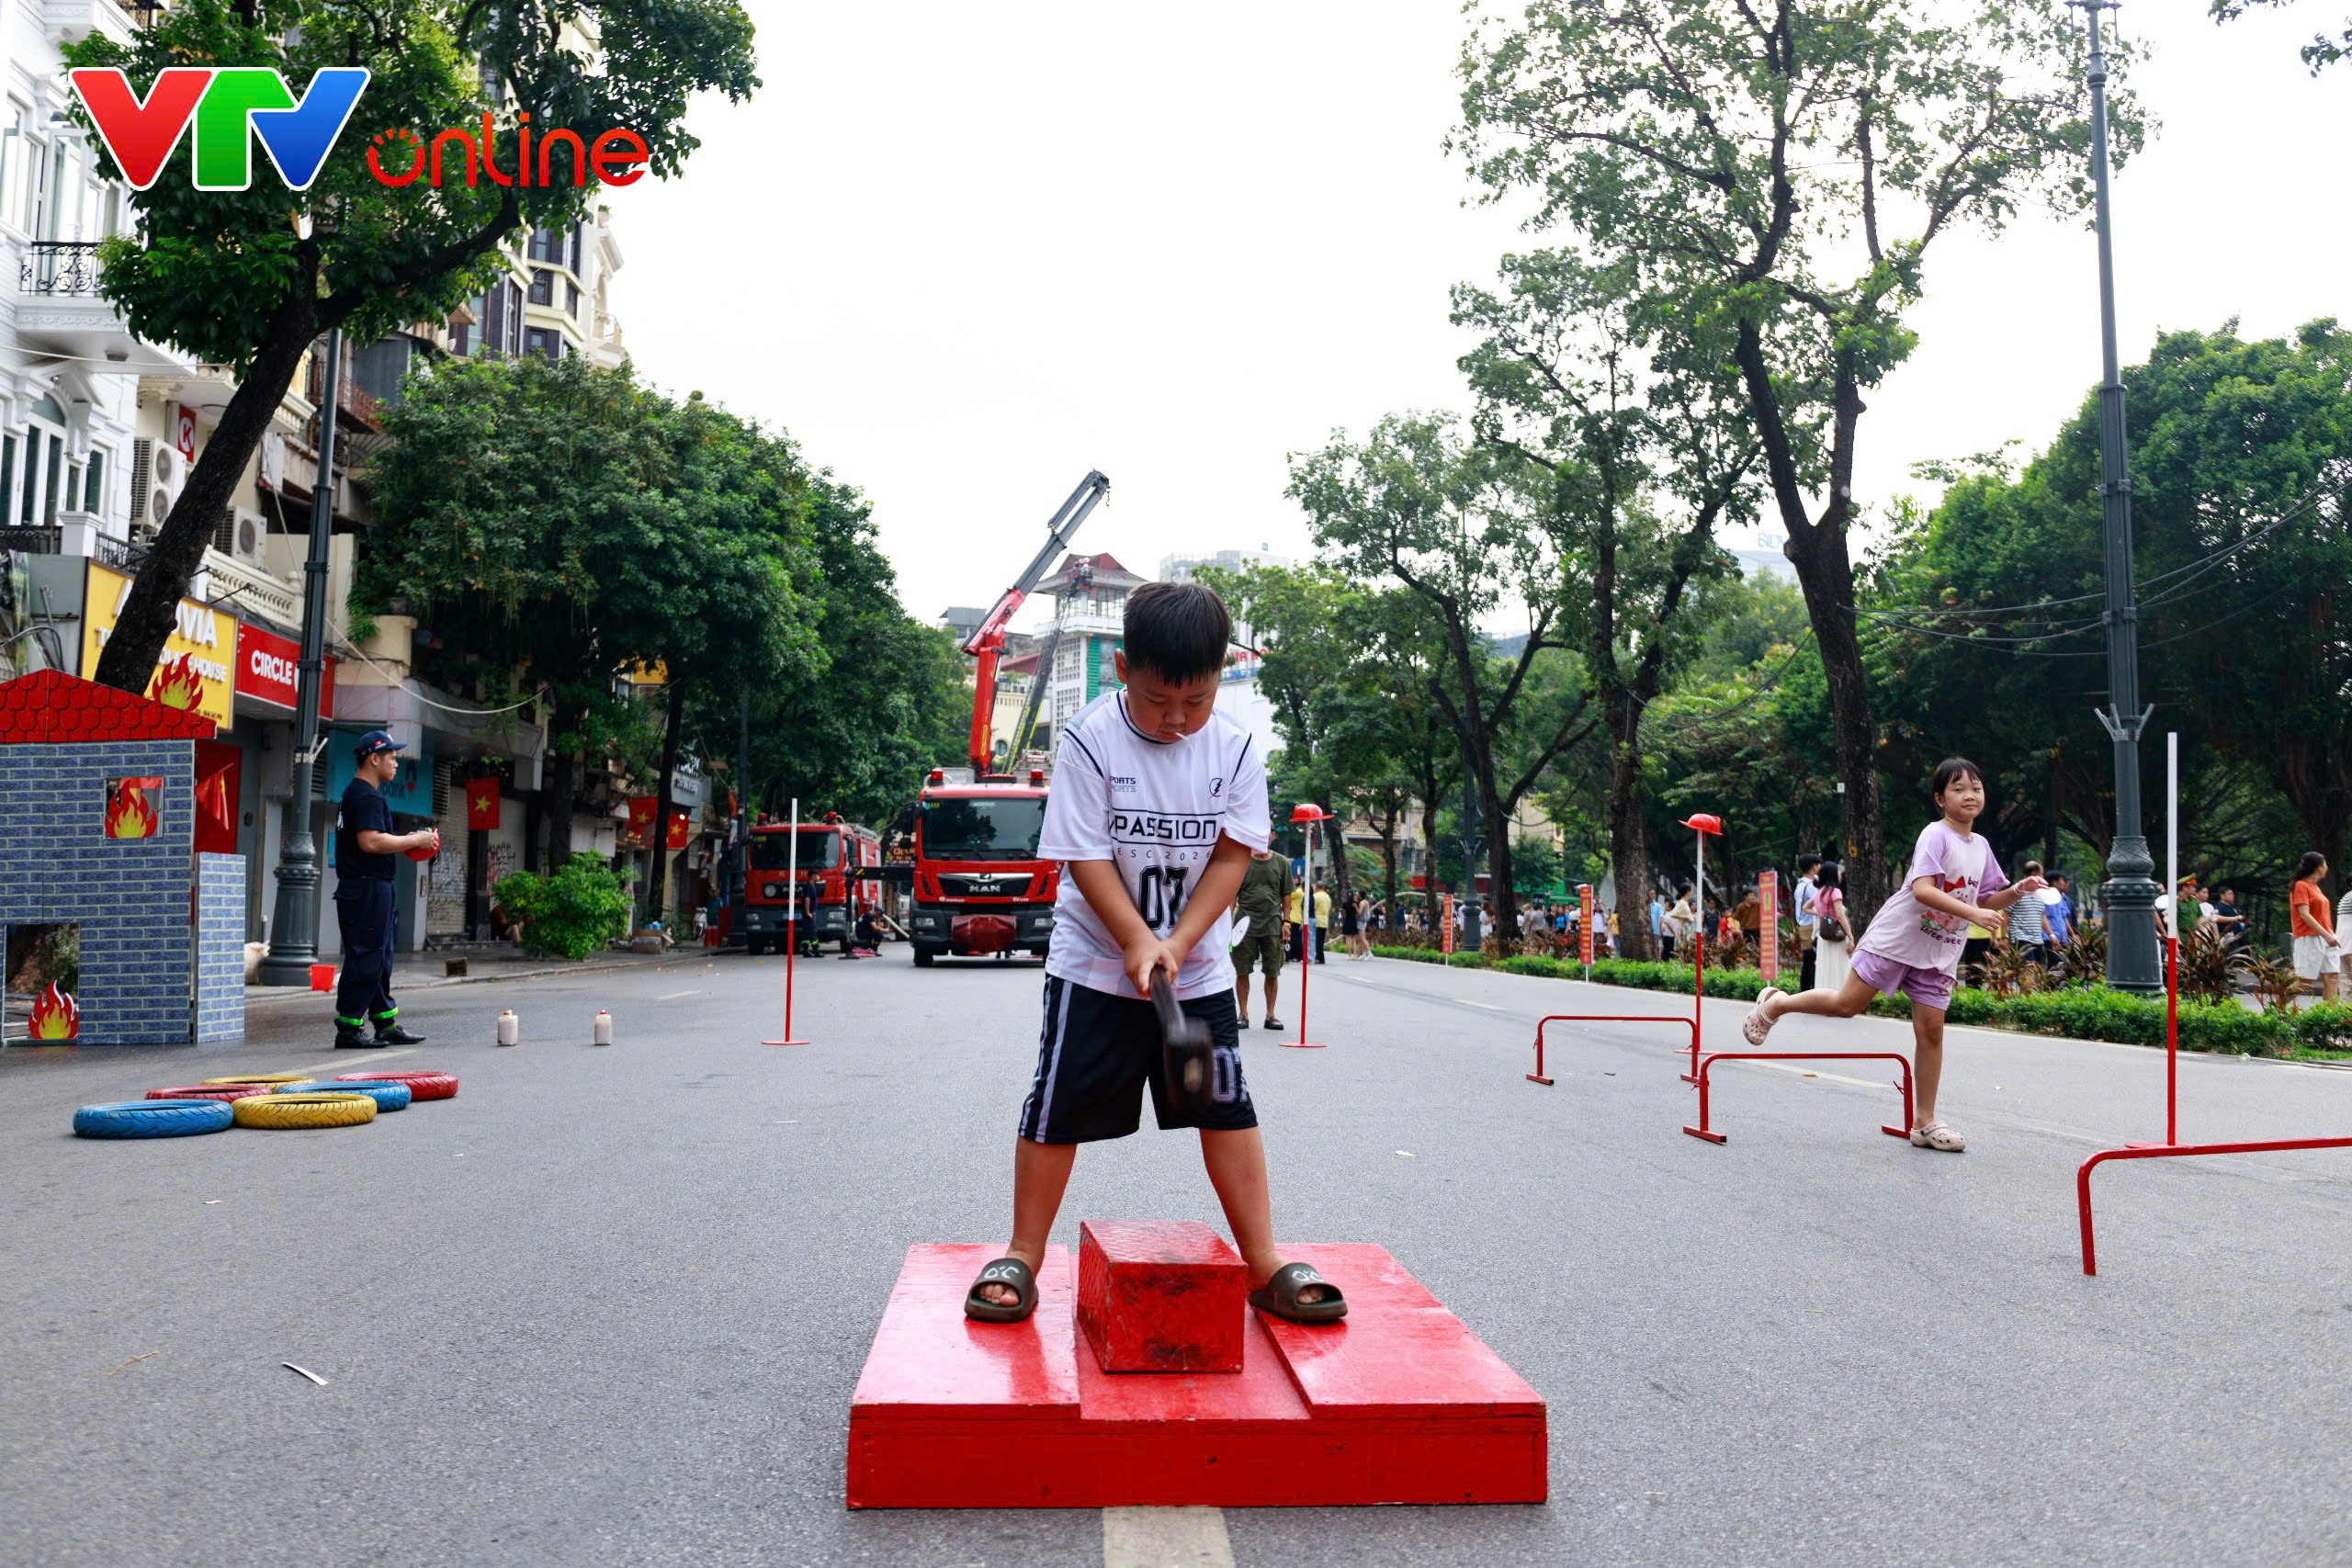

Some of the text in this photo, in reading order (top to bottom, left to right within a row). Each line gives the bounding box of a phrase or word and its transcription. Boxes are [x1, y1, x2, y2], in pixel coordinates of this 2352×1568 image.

[251, 649, 293, 685] CIRCLE
[1110, 776, 1136, 784] PORTS
[1139, 865, 1189, 930] 07
